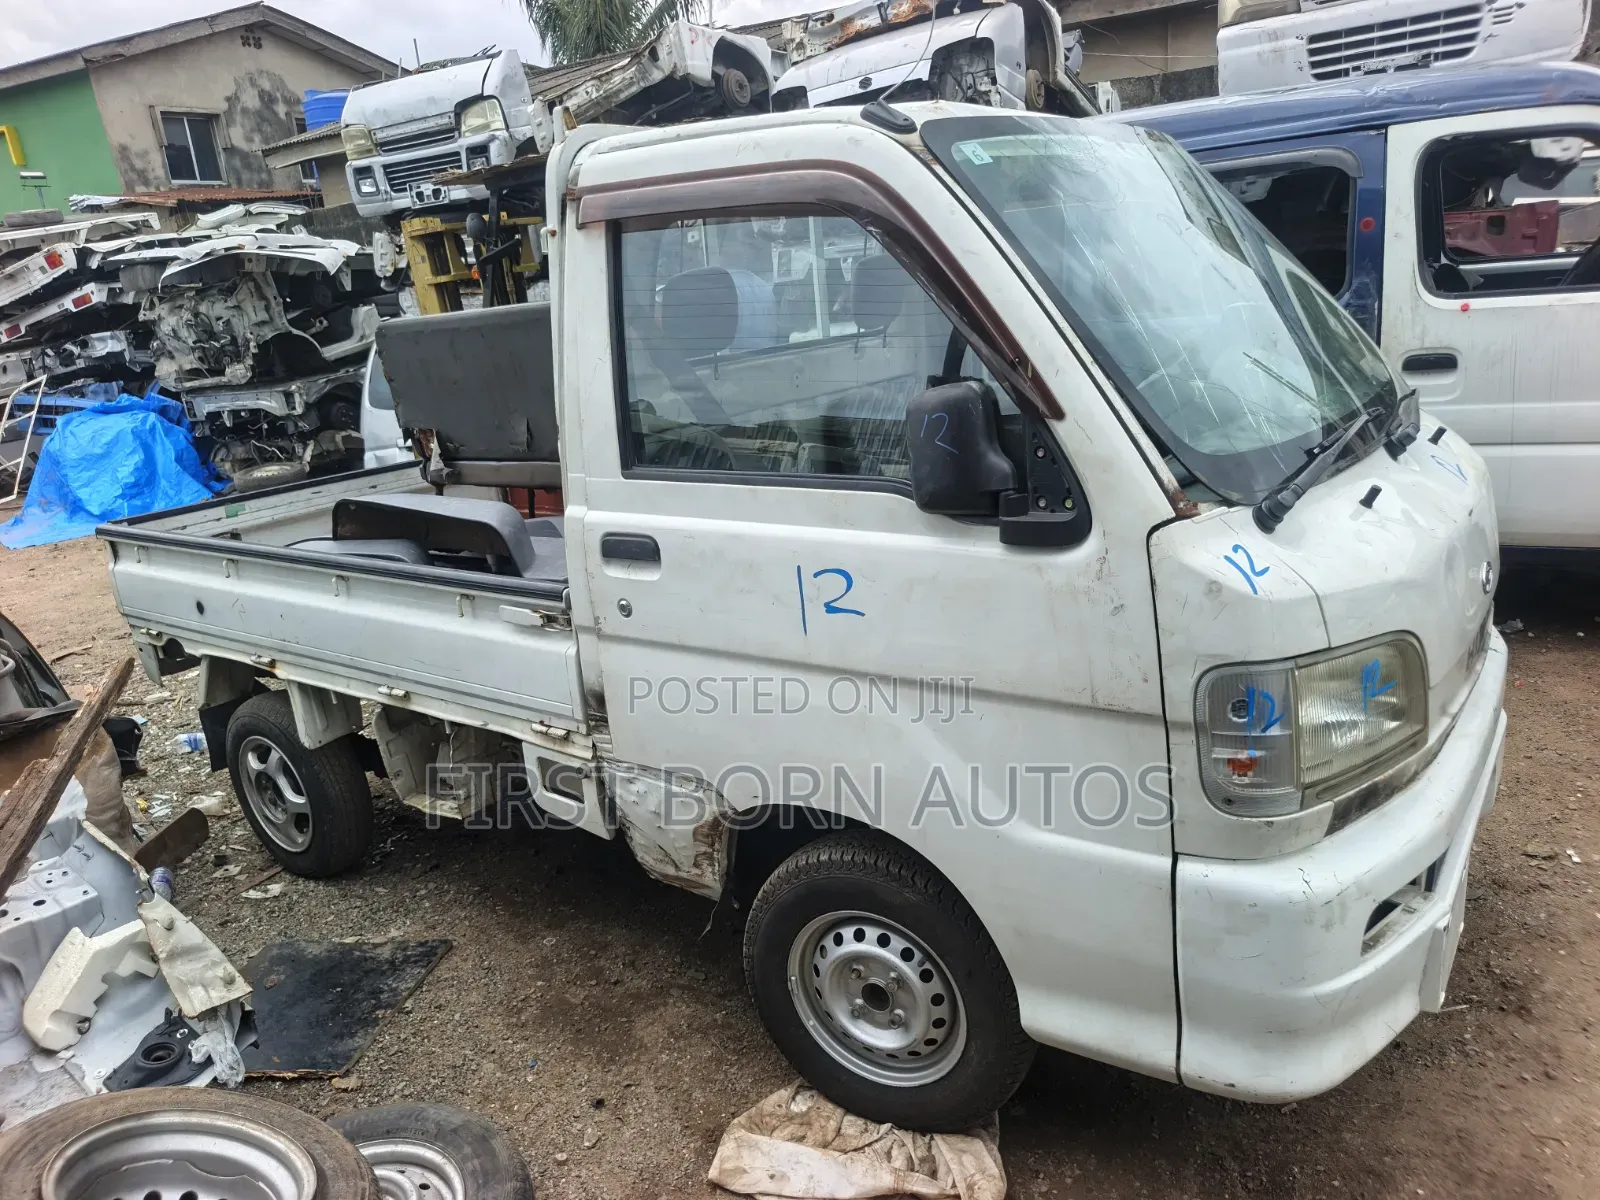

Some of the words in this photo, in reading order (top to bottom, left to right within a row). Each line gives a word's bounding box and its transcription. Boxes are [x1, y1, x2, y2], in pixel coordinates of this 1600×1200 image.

[920, 412, 960, 455] 12
[1223, 543, 1270, 596] 12
[796, 564, 866, 637] 12
[1246, 685, 1286, 742] 12
[1362, 658, 1398, 714] 12
